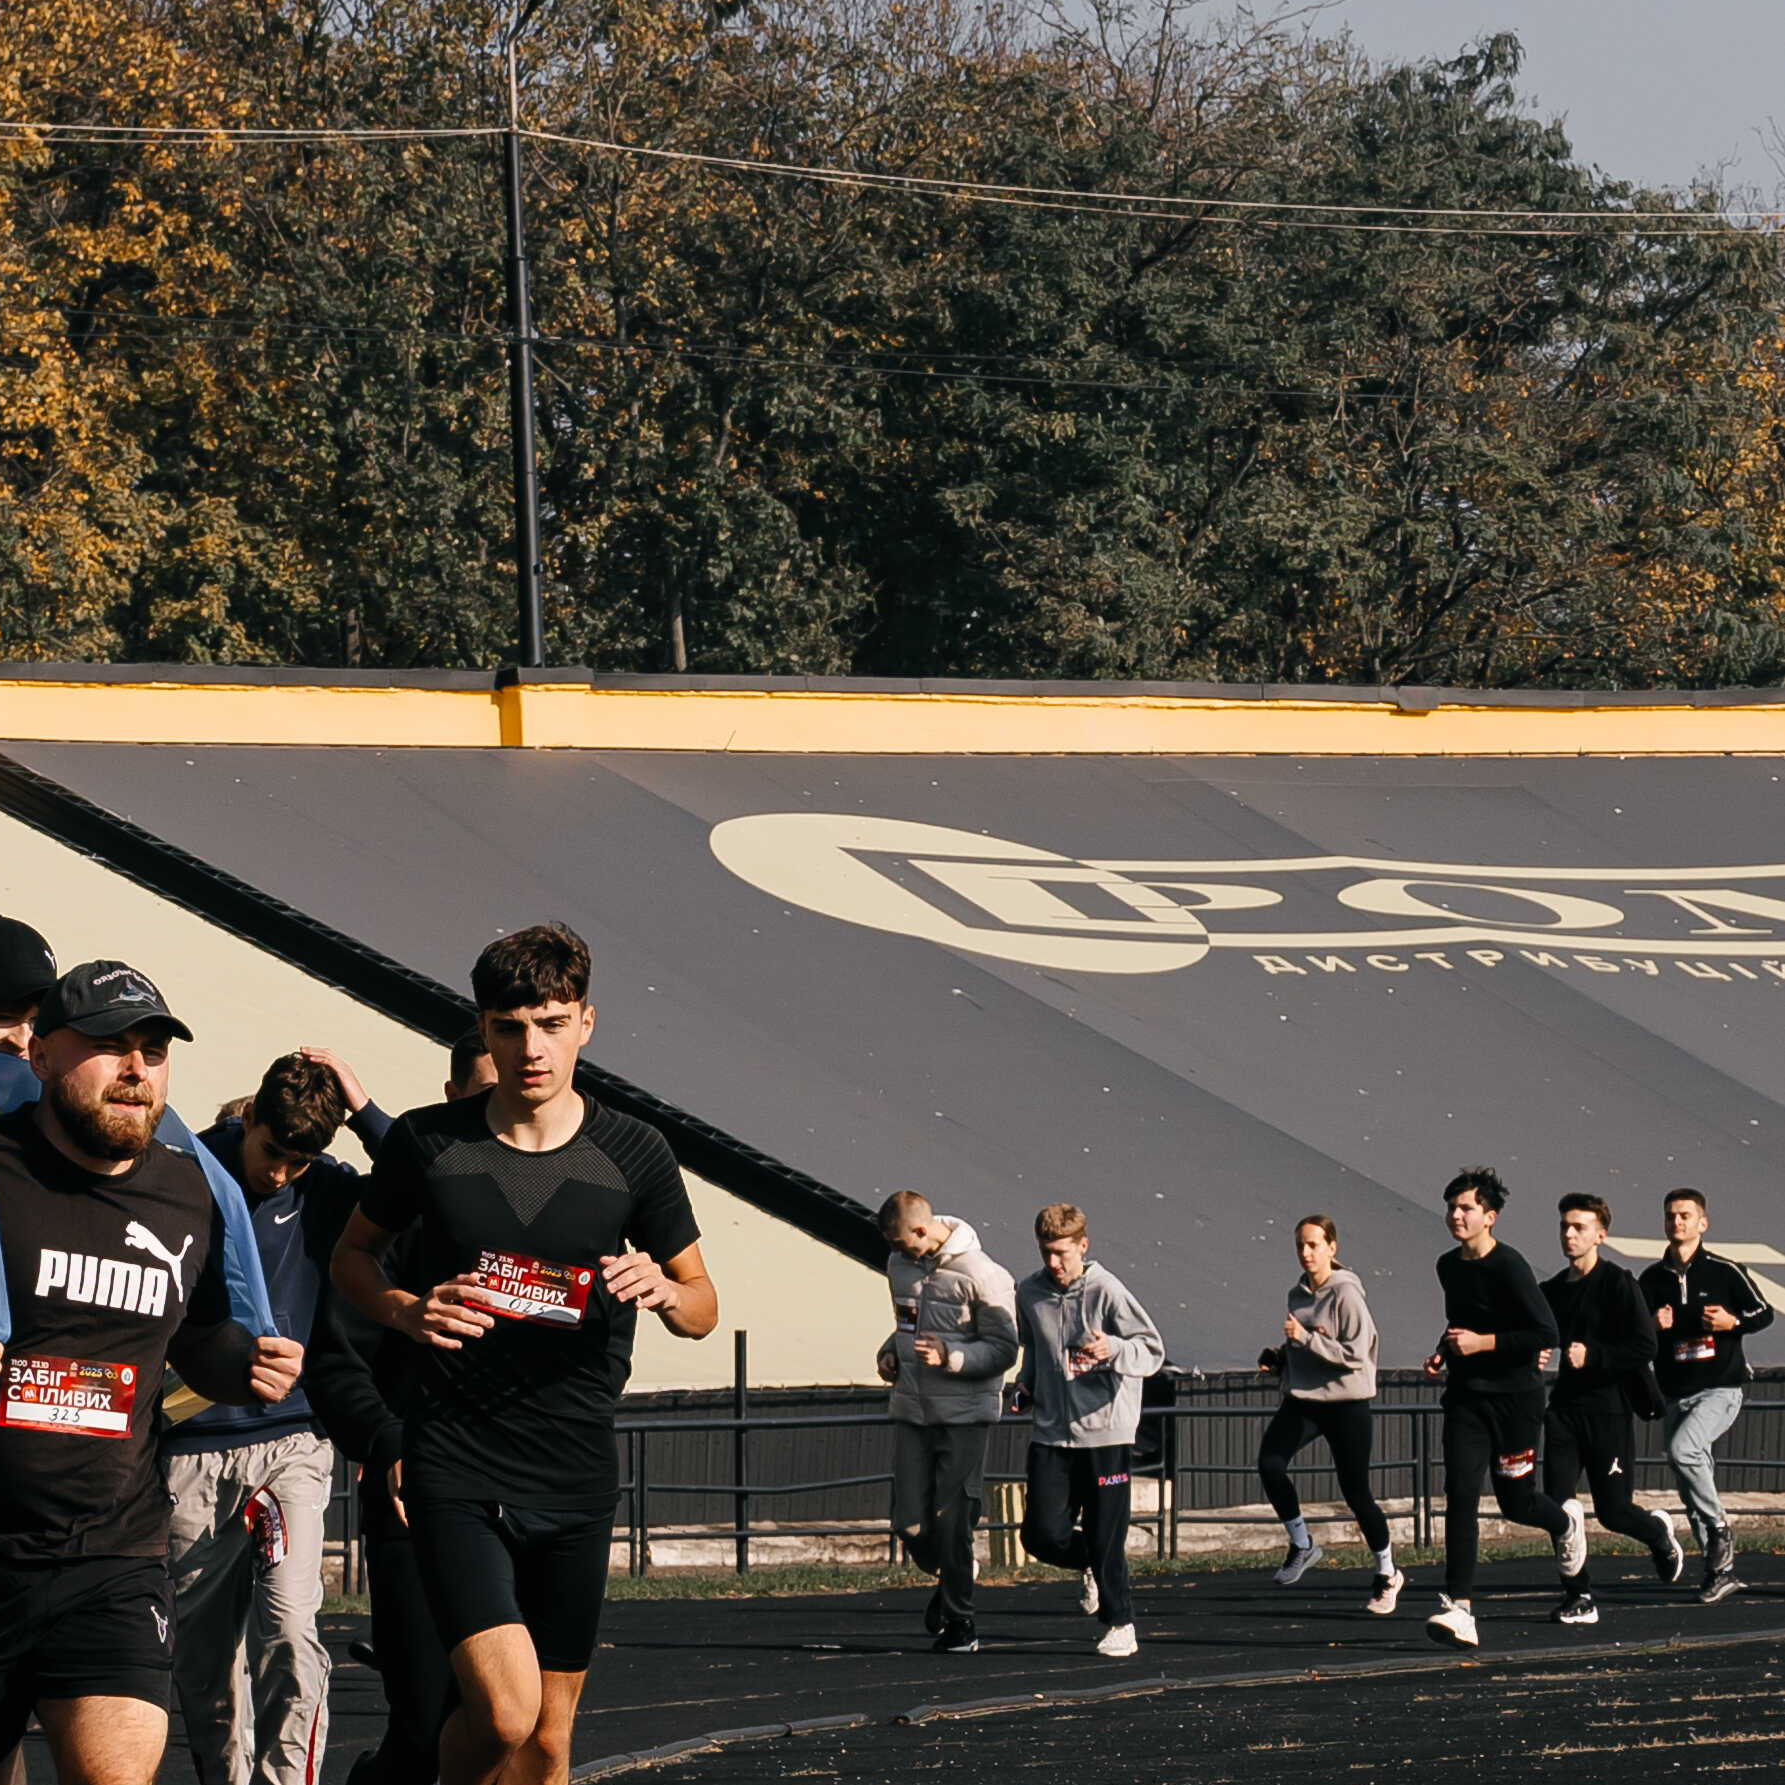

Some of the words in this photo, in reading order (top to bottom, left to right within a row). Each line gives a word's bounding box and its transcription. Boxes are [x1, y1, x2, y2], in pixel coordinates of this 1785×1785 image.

[477, 1257, 529, 1281] ЗАБІГ
[34, 1248, 169, 1317] PUMA
[8, 1367, 68, 1387] ЗАБІГ
[79, 1366, 103, 1378] 2025
[47, 1407, 81, 1423] 325
